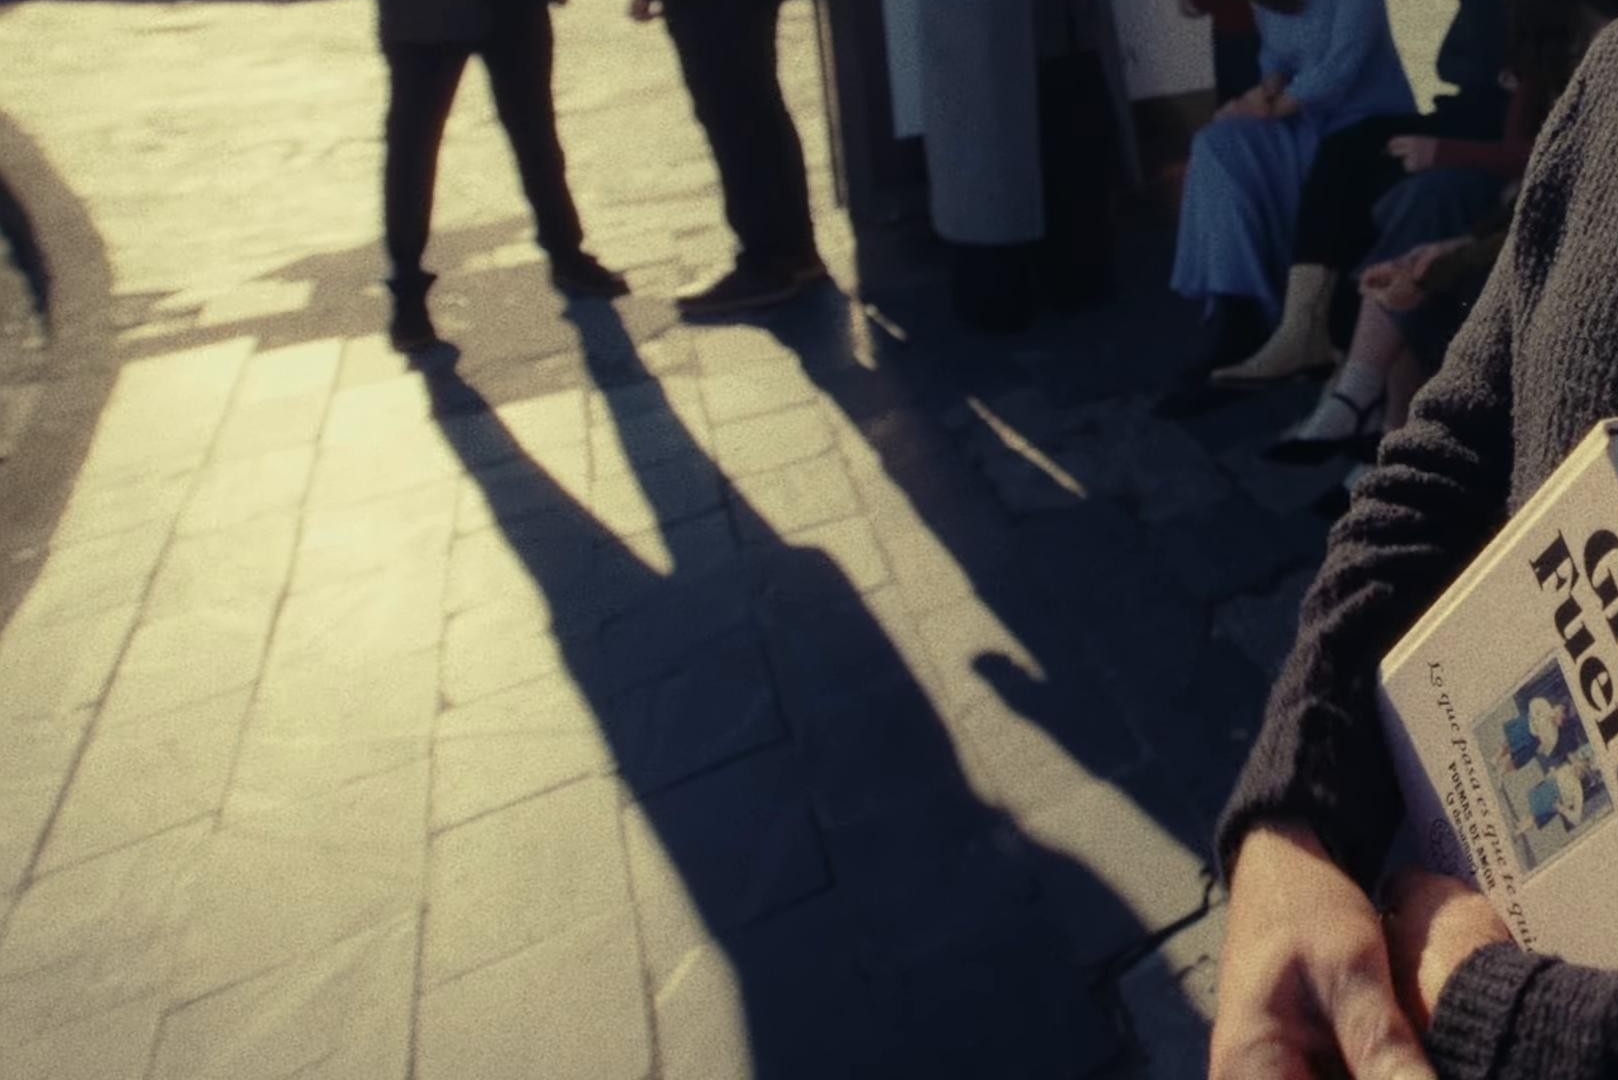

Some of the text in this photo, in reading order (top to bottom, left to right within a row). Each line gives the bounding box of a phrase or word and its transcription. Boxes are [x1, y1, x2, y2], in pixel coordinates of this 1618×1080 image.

[1427, 662, 1444, 687] Lo
[1437, 693, 1460, 732] que
[1451, 739, 1480, 790] pasa
[1476, 797, 1489, 817] es
[1484, 824, 1507, 866] que
[1502, 874, 1516, 895] te
[1448, 761, 1497, 892] POEMAS DE AMOR
